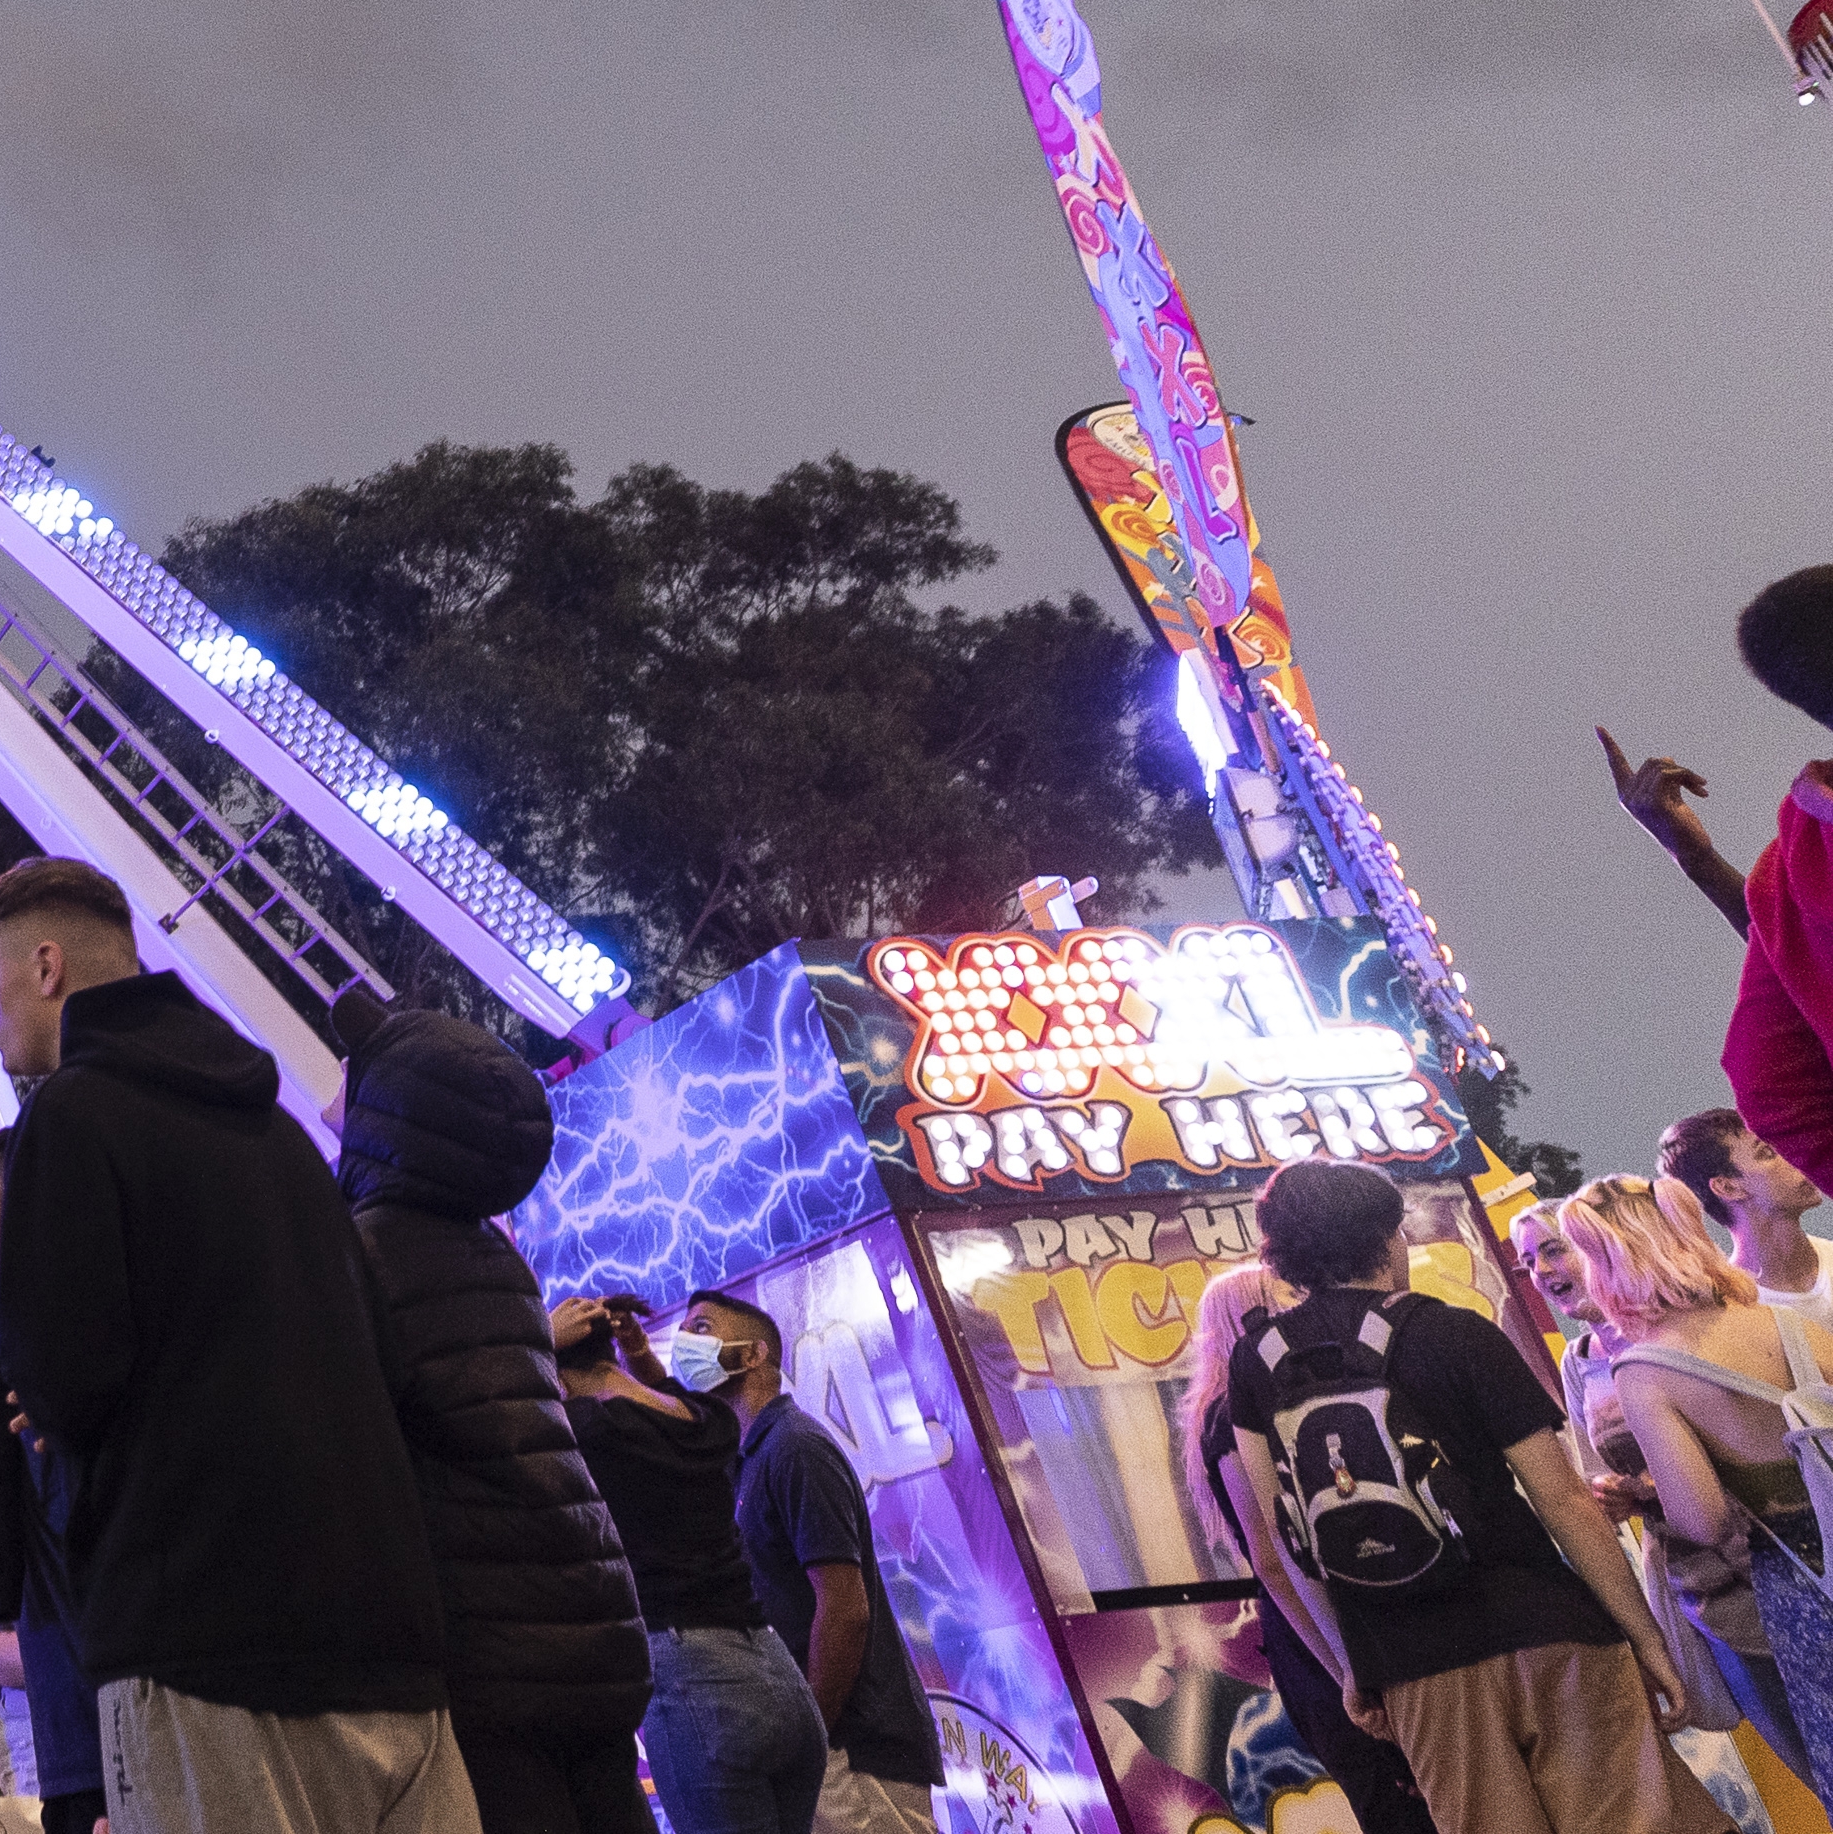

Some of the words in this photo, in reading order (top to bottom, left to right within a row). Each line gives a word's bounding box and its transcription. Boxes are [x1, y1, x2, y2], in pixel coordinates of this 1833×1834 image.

[875, 926, 1414, 1108] XXXL
[914, 1099, 1131, 1186] PAY
[1161, 1078, 1439, 1168] HERE
[1012, 1210, 1158, 1267] PAY
